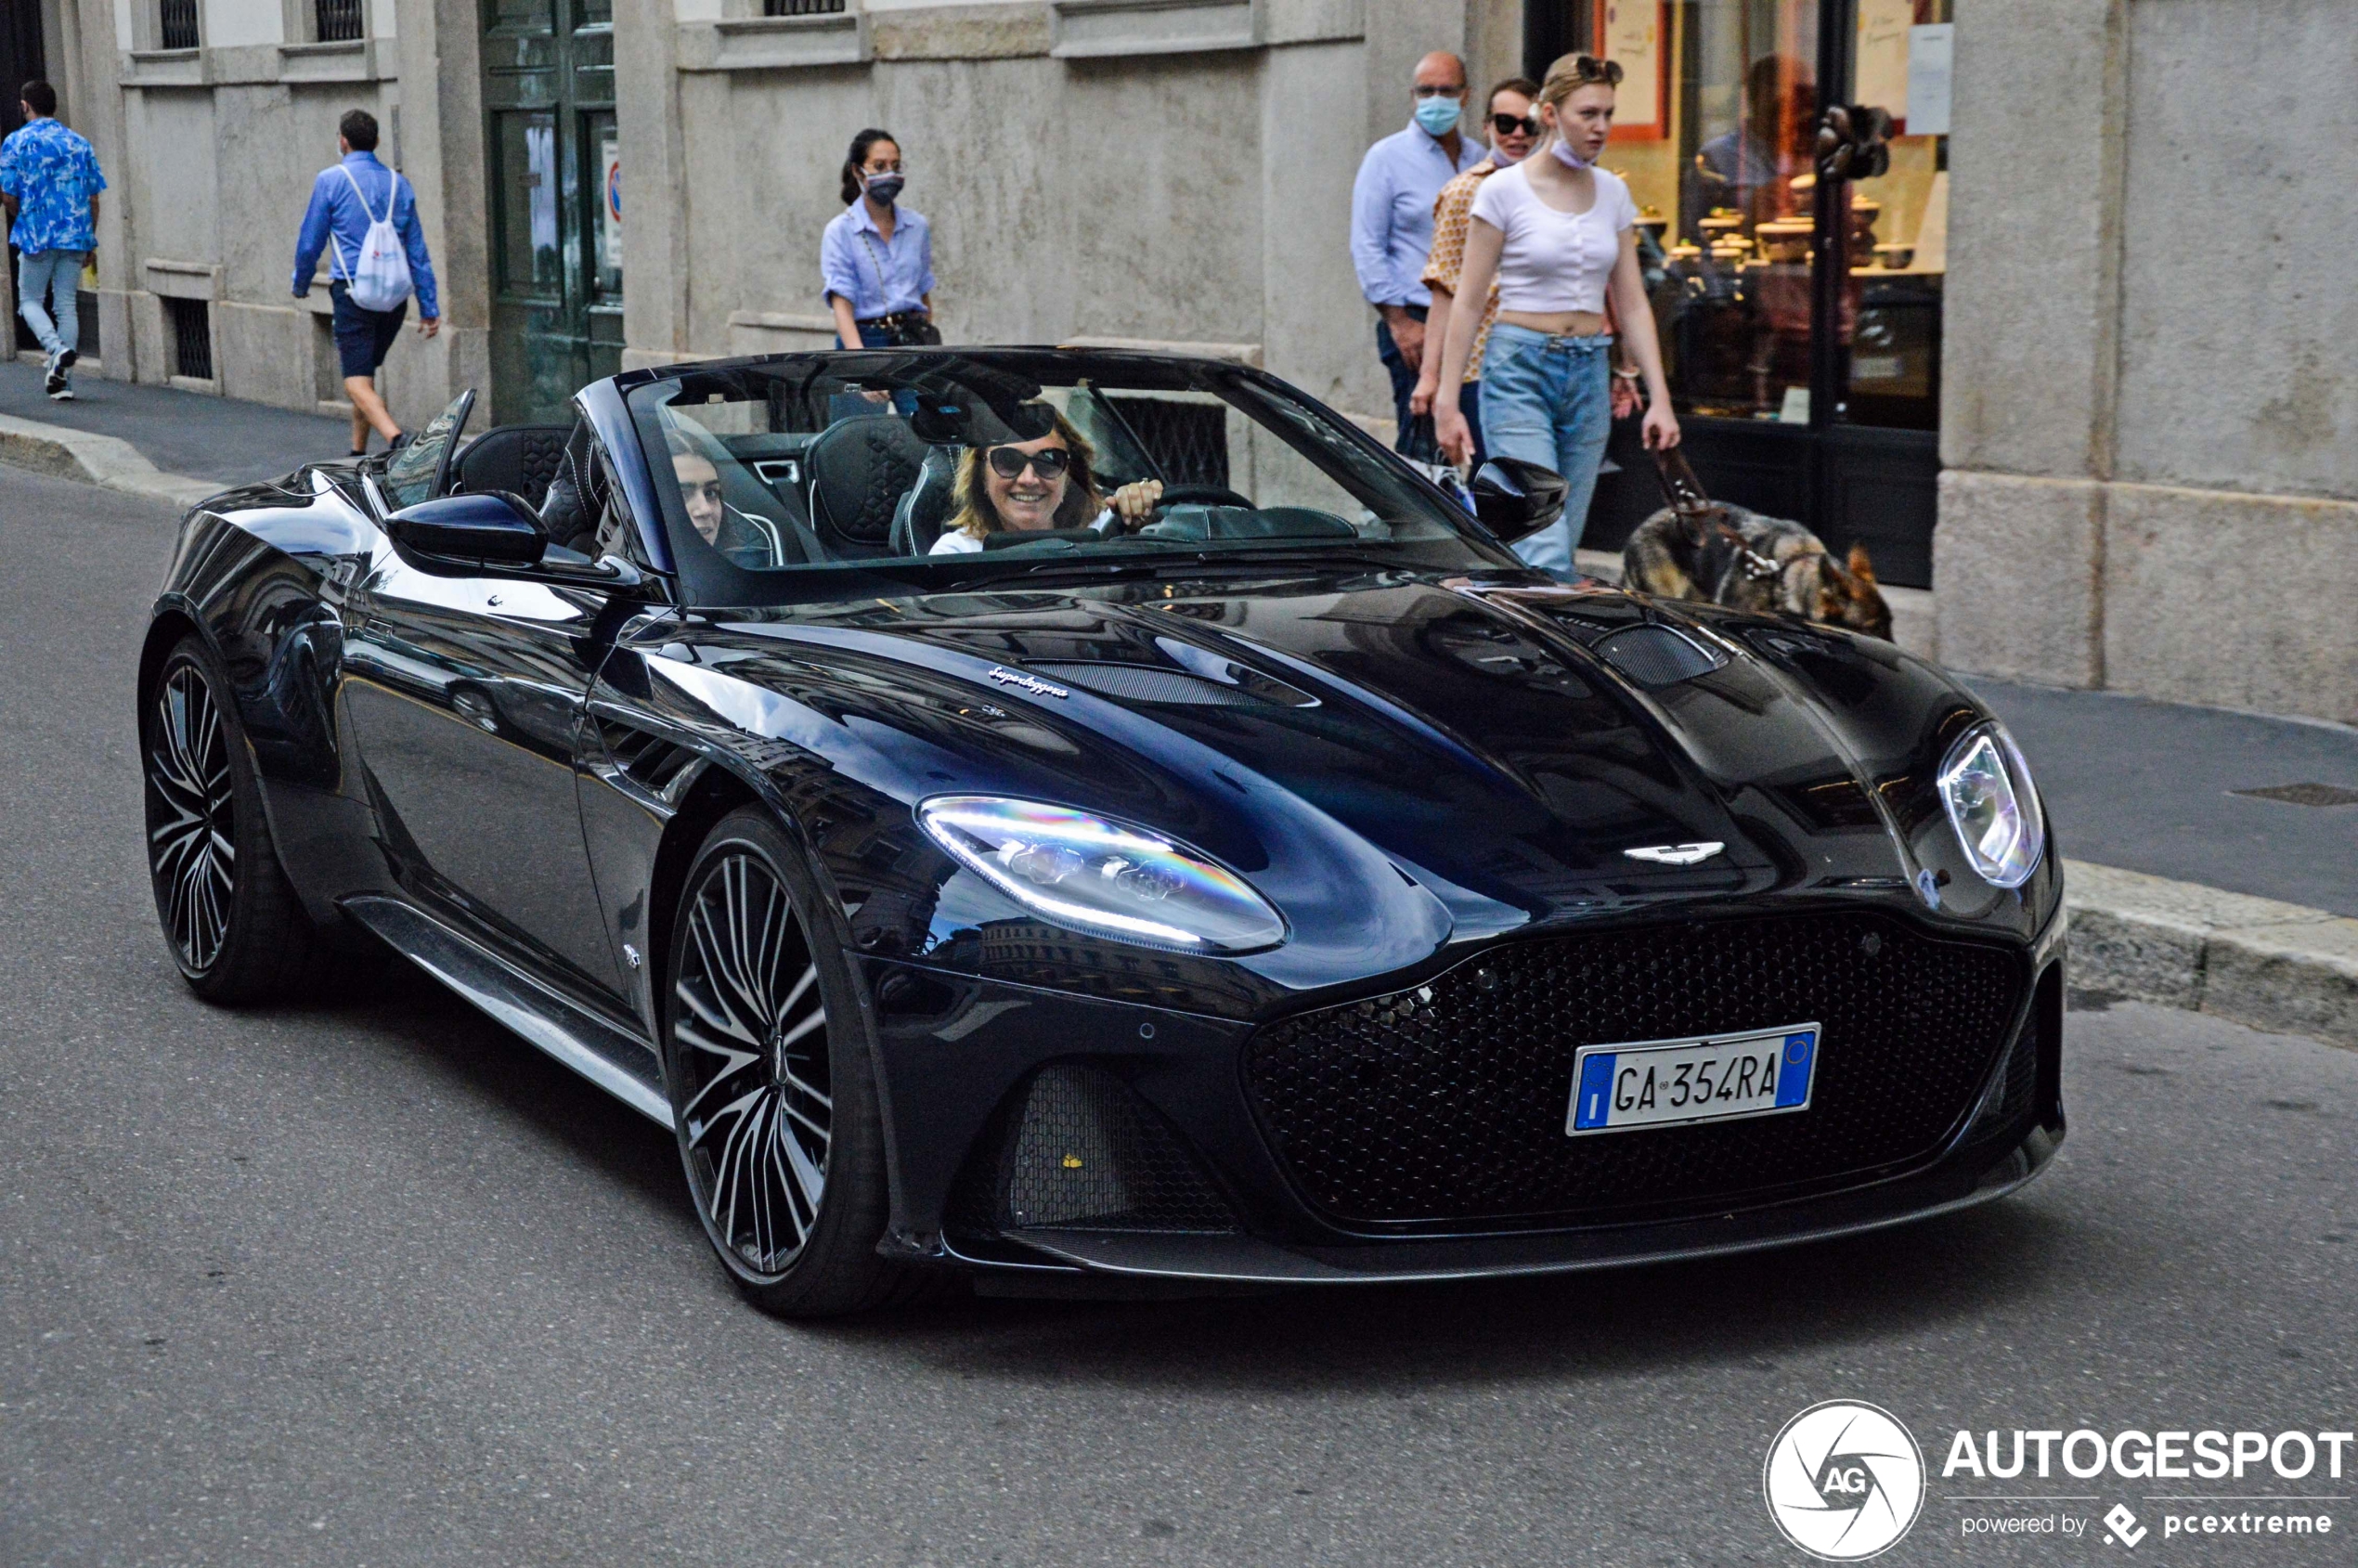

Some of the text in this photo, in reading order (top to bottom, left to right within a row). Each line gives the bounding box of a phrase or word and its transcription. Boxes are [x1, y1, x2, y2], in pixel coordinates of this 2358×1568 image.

[988, 666, 1069, 696] Superleggera
[1614, 1052, 1776, 1111] GA 354RA
